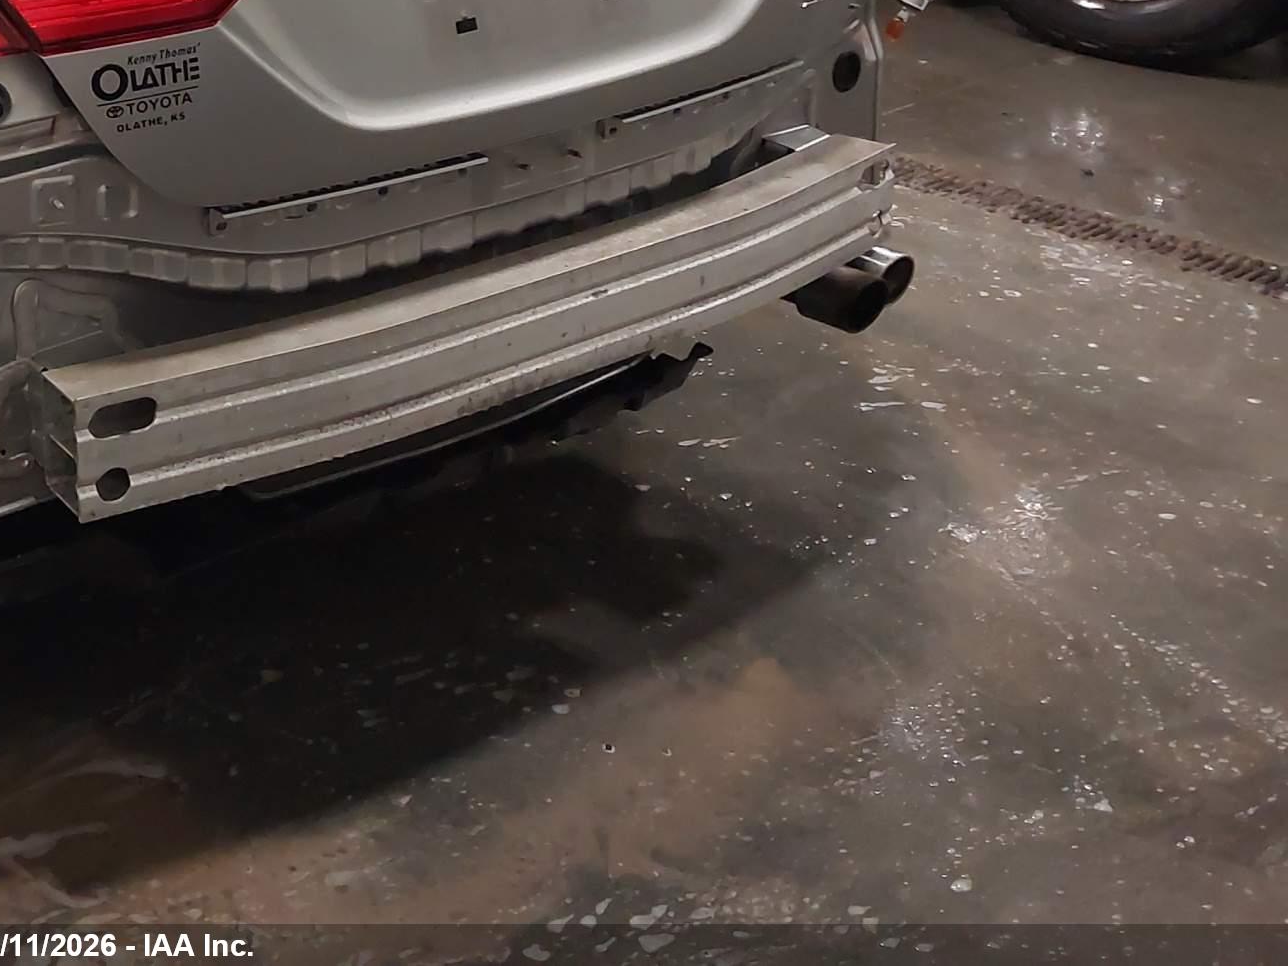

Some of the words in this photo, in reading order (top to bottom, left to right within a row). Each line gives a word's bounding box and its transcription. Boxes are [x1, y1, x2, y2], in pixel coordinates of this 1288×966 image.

[127, 53, 158, 66] Kenny
[91, 56, 201, 102] OLATHE
[126, 92, 193, 115] TOYOTA
[116, 116, 168, 133] OLATHE,
[170, 112, 186, 122] KS
